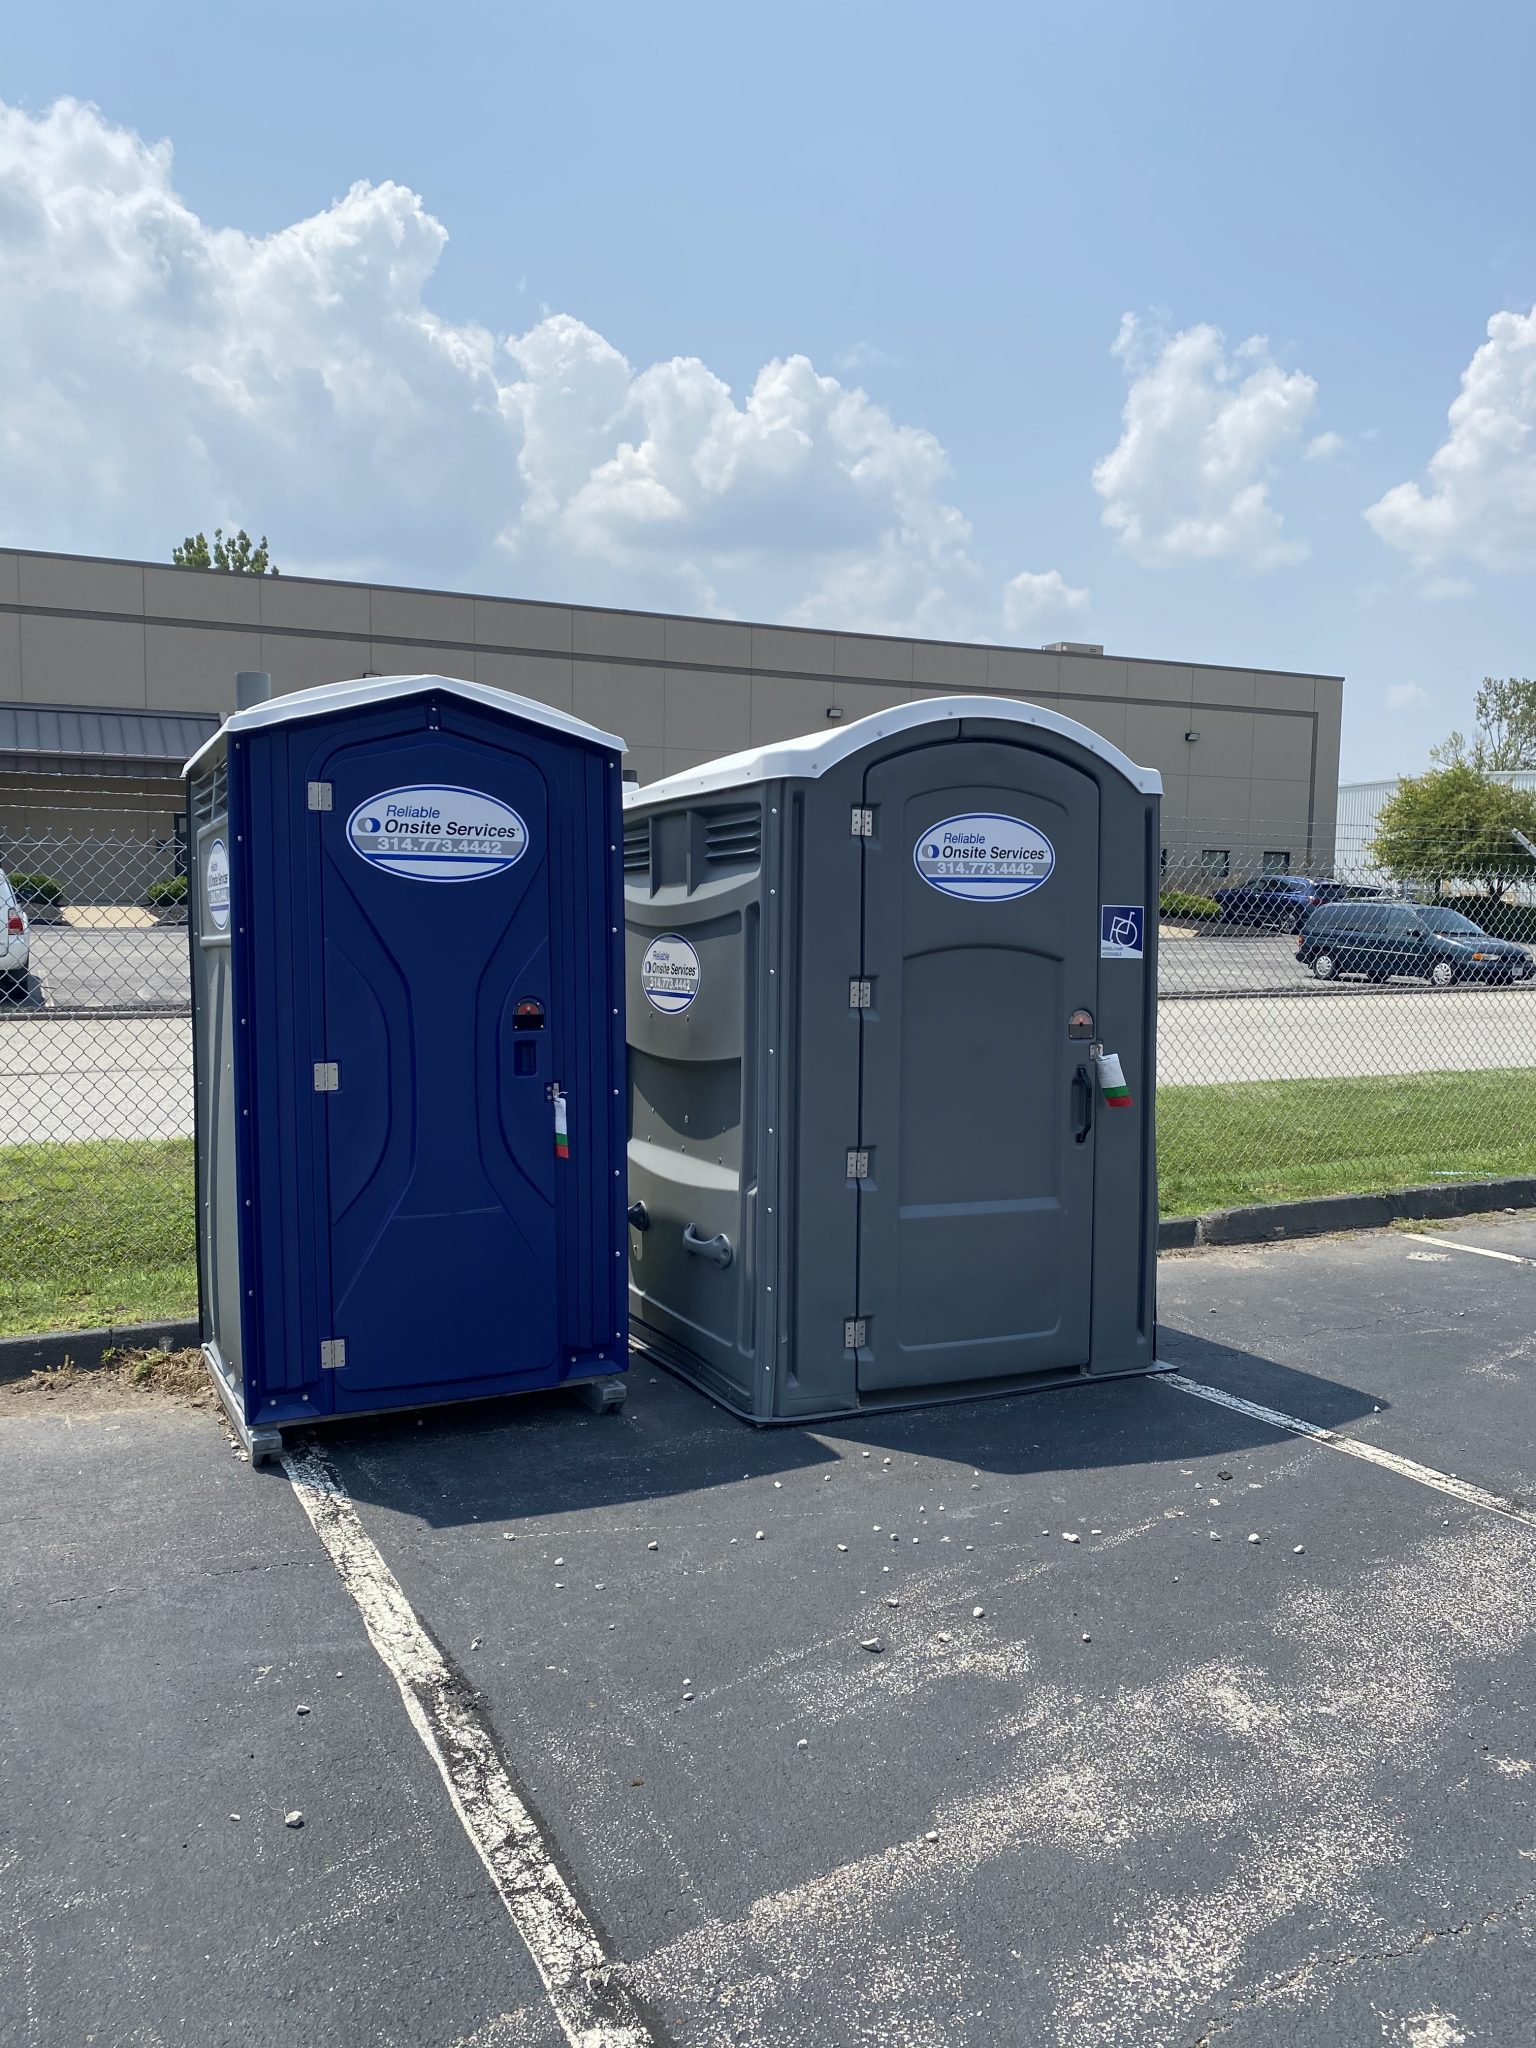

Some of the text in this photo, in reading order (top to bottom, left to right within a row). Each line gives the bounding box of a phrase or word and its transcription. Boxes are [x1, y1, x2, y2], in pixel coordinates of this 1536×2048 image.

[386, 804, 440, 819] Reliable
[385, 819, 516, 838] Onsite Services
[377, 836, 503, 854] 314.773.4442
[944, 832, 985, 844] Reliable
[942, 845, 1045, 860] Onsite Services
[937, 862, 1034, 875] 314.773.4442
[653, 950, 670, 960] Reliable
[652, 962, 696, 977] Onsite Services
[649, 977, 691, 990] 314.773.4442
